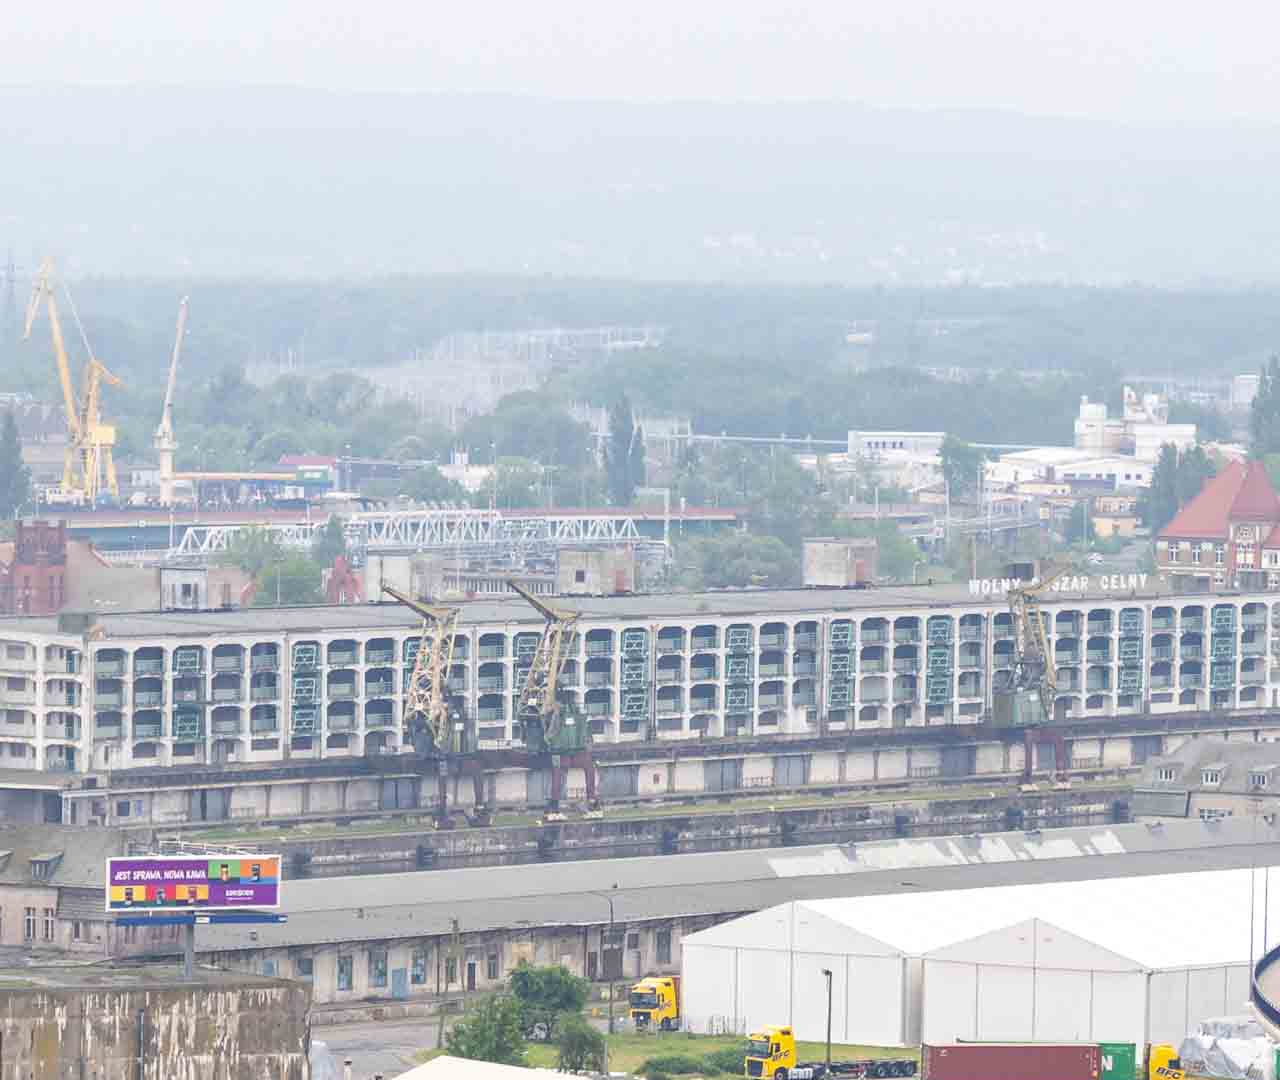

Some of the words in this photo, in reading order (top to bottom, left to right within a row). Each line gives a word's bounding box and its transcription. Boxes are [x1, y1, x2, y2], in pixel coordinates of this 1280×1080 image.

[968, 578, 1021, 594] WOLNY
[1100, 573, 1148, 590] CELNY
[114, 870, 130, 881] JEST
[163, 869, 184, 880] NOWA
[185, 869, 207, 880] KAWA
